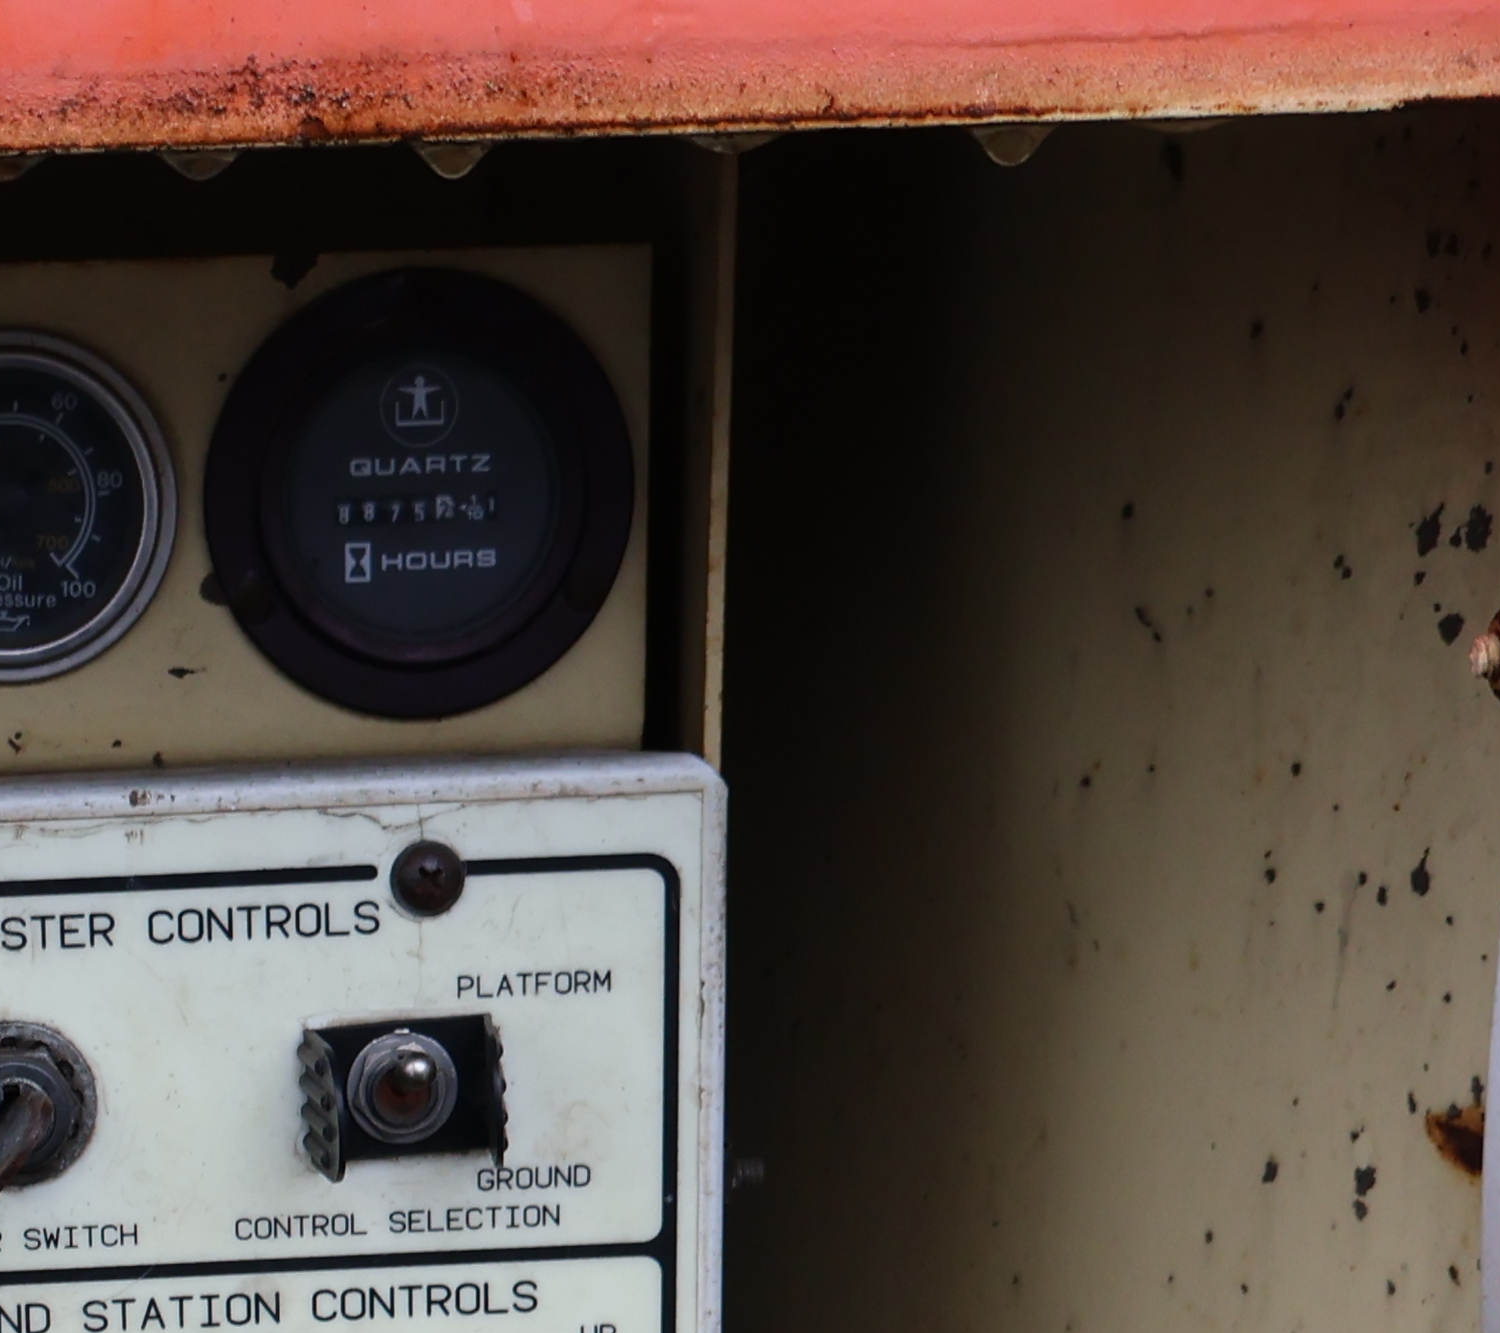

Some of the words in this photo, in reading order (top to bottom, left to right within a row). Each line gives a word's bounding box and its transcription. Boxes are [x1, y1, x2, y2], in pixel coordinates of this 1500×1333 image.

[51, 392, 77, 410] 60
[349, 453, 492, 478] QUARTZ
[97, 470, 122, 488] 80
[380, 548, 497, 572] HOURS
[60, 580, 96, 598] 100
[148, 900, 380, 945] CONTROLS
[457, 970, 611, 999] PLATFORM
[477, 1164, 591, 1191] GROUND
[235, 1213, 367, 1240] CONTROL
[389, 1204, 560, 1233] SELECTION
[24, 1224, 137, 1250] SWITCH
[83, 1291, 280, 1333] STATION
[312, 1280, 537, 1322] CONTROLS
